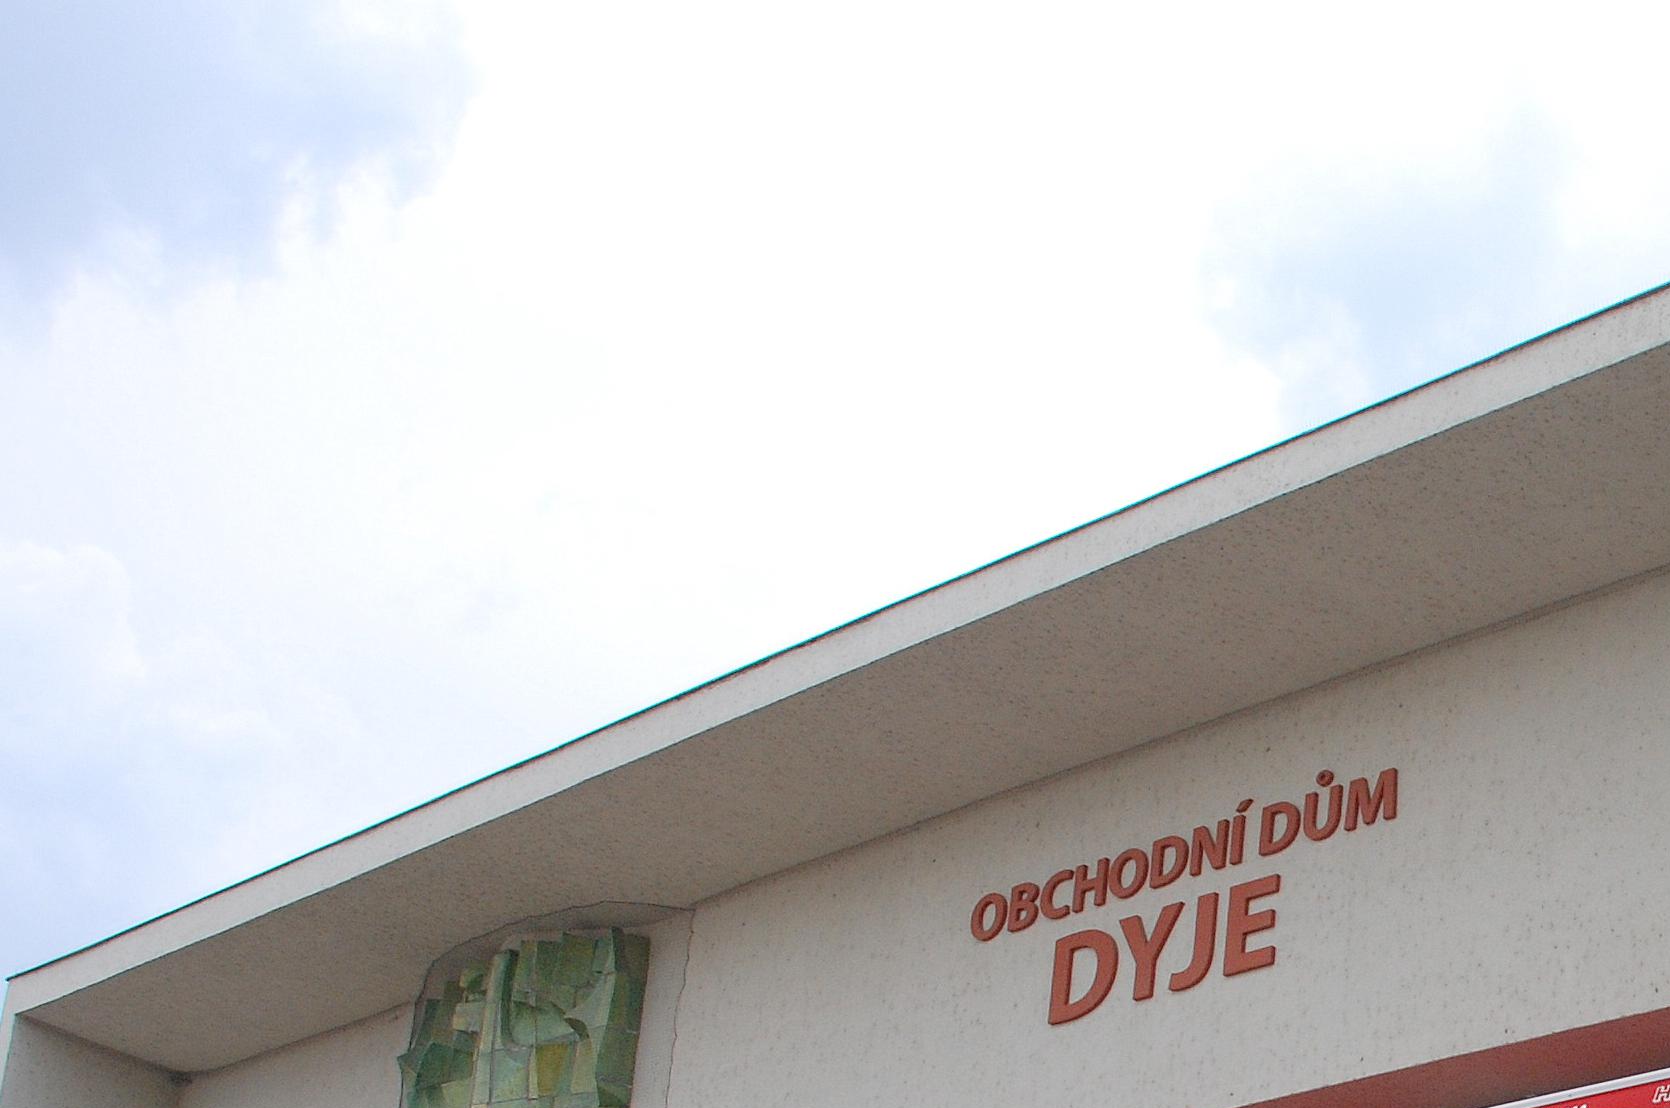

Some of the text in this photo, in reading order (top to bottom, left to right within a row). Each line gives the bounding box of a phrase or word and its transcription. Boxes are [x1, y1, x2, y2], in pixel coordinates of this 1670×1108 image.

[970, 768, 1398, 942] OBCHODNÍ DŮM
[1048, 874, 1281, 1025] DYJE
